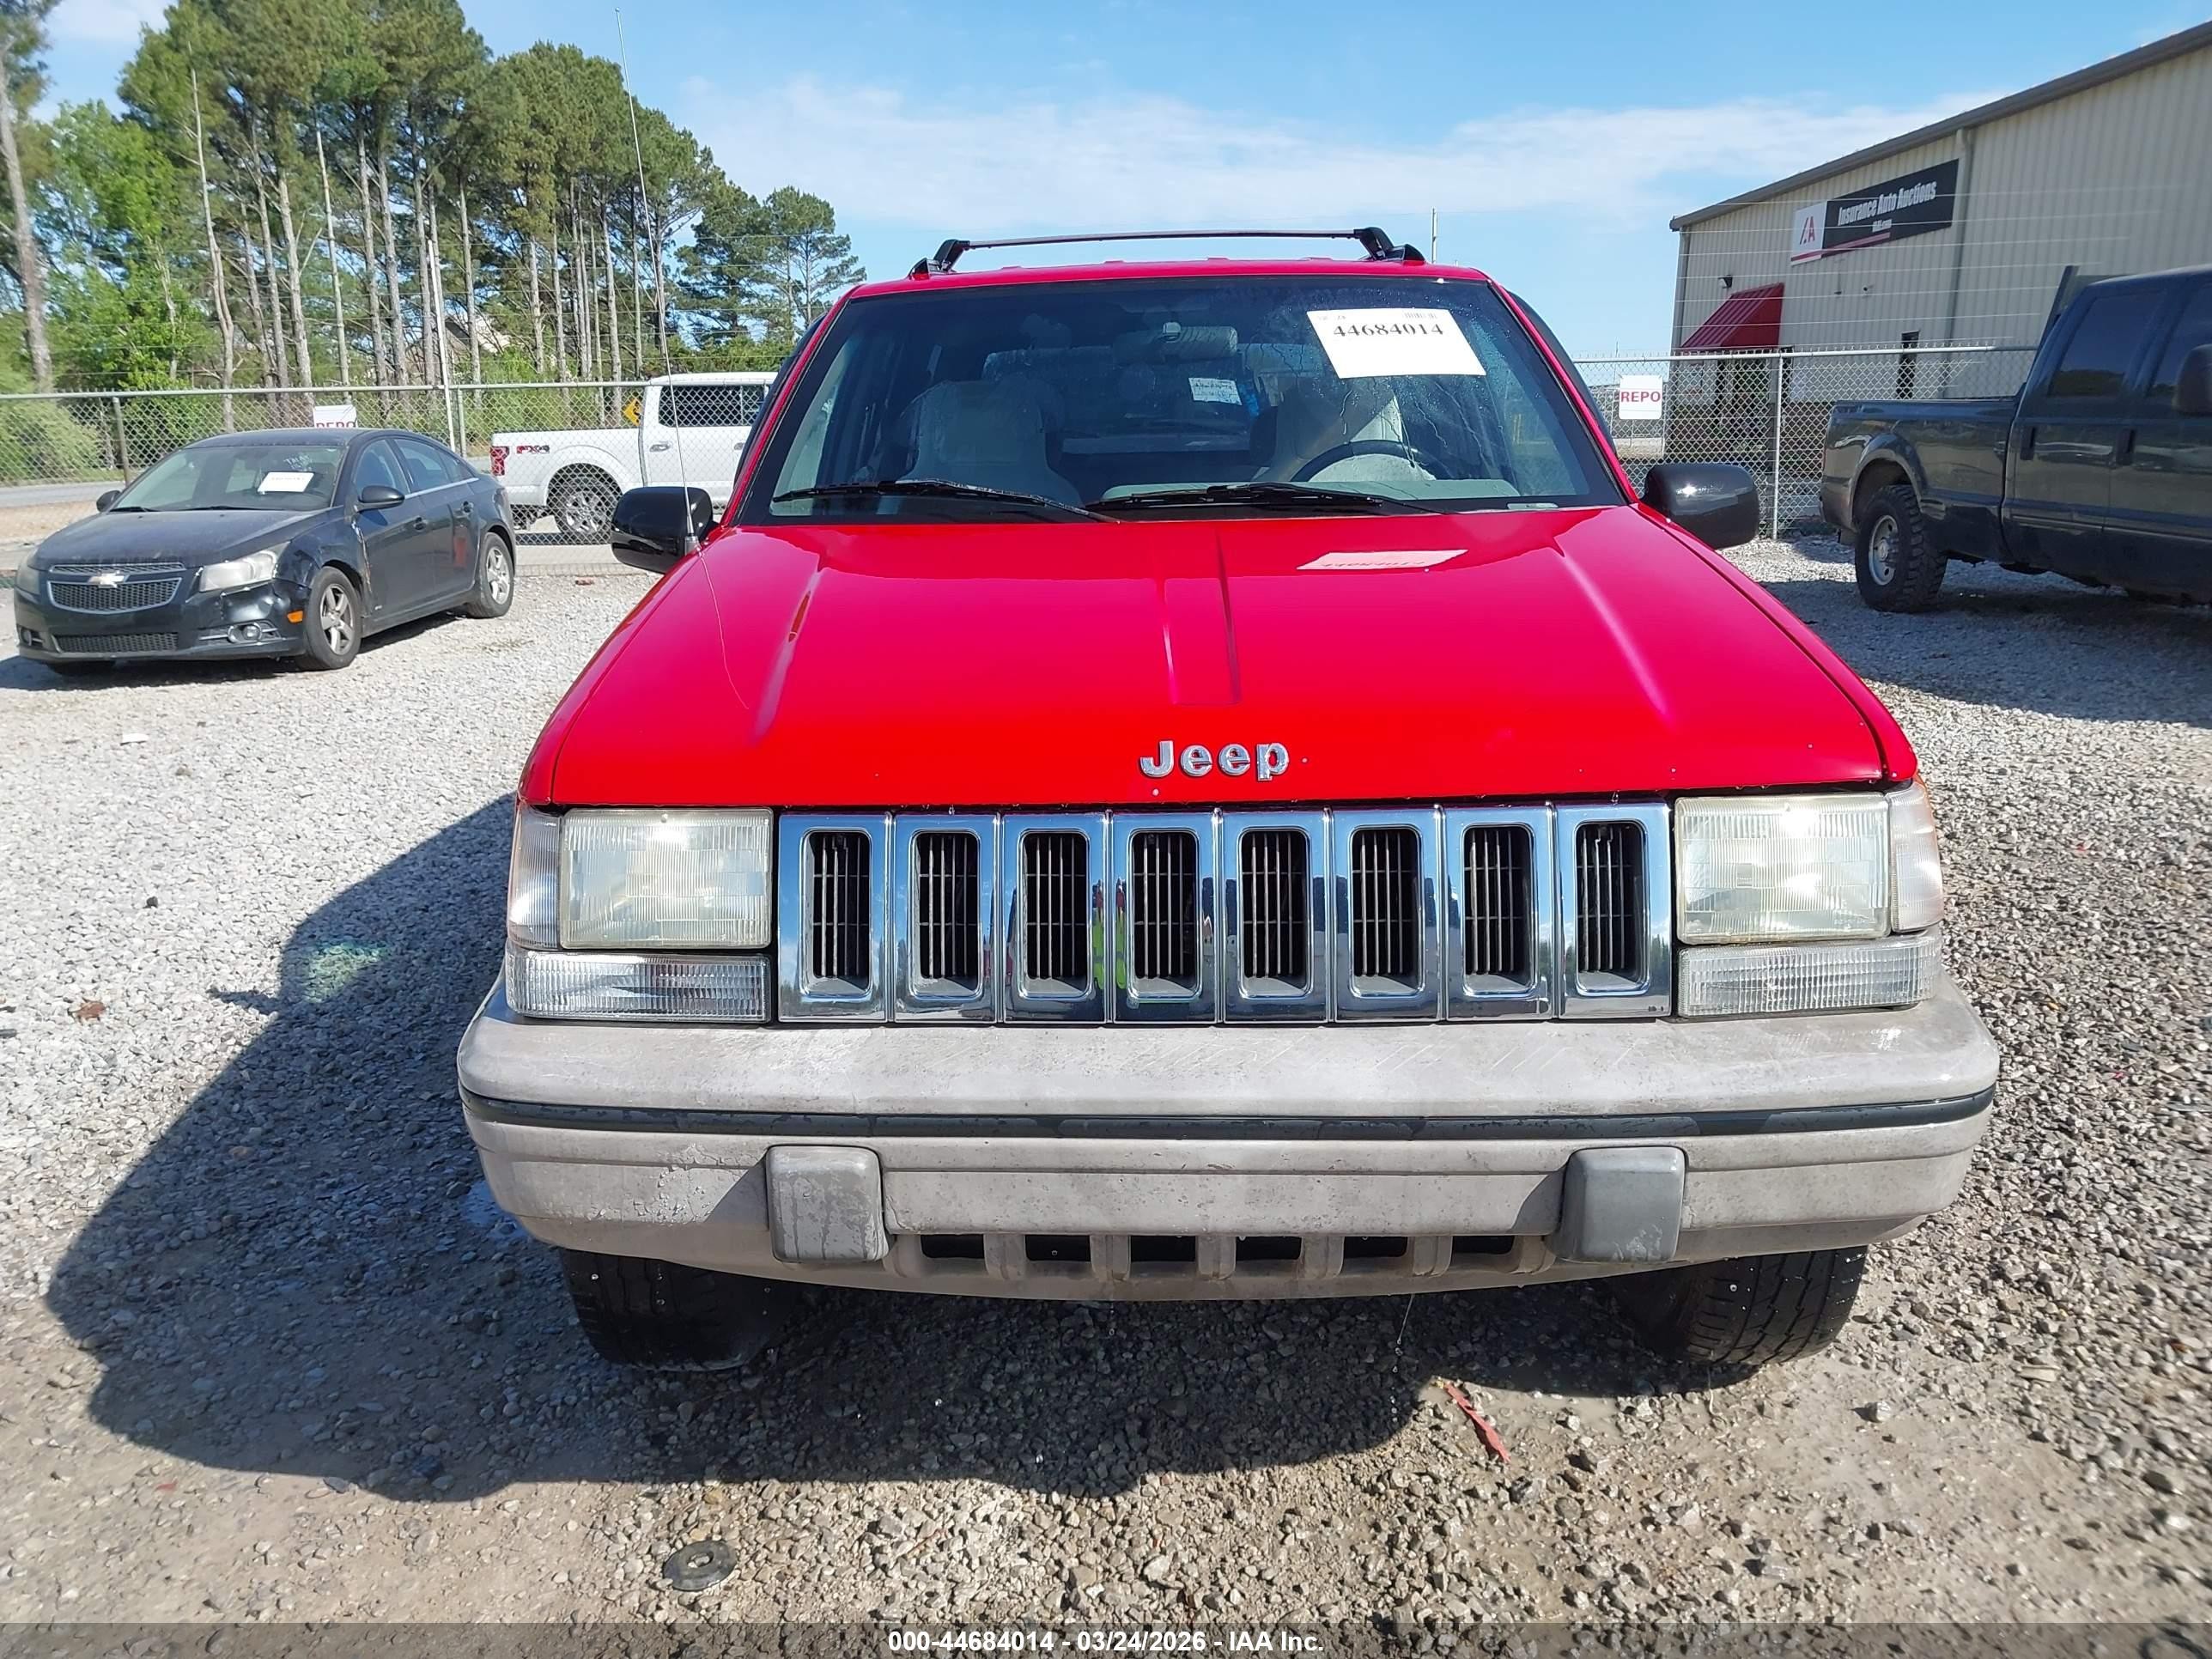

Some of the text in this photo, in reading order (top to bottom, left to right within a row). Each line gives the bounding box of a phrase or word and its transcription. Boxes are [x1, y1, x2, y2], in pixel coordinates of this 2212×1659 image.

[1838, 181, 1937, 226] Insurance Auto Auctions
[1333, 323, 1443, 337] 44684014
[1620, 391, 1661, 403] REPO
[1139, 740, 1290, 781] Jeep
